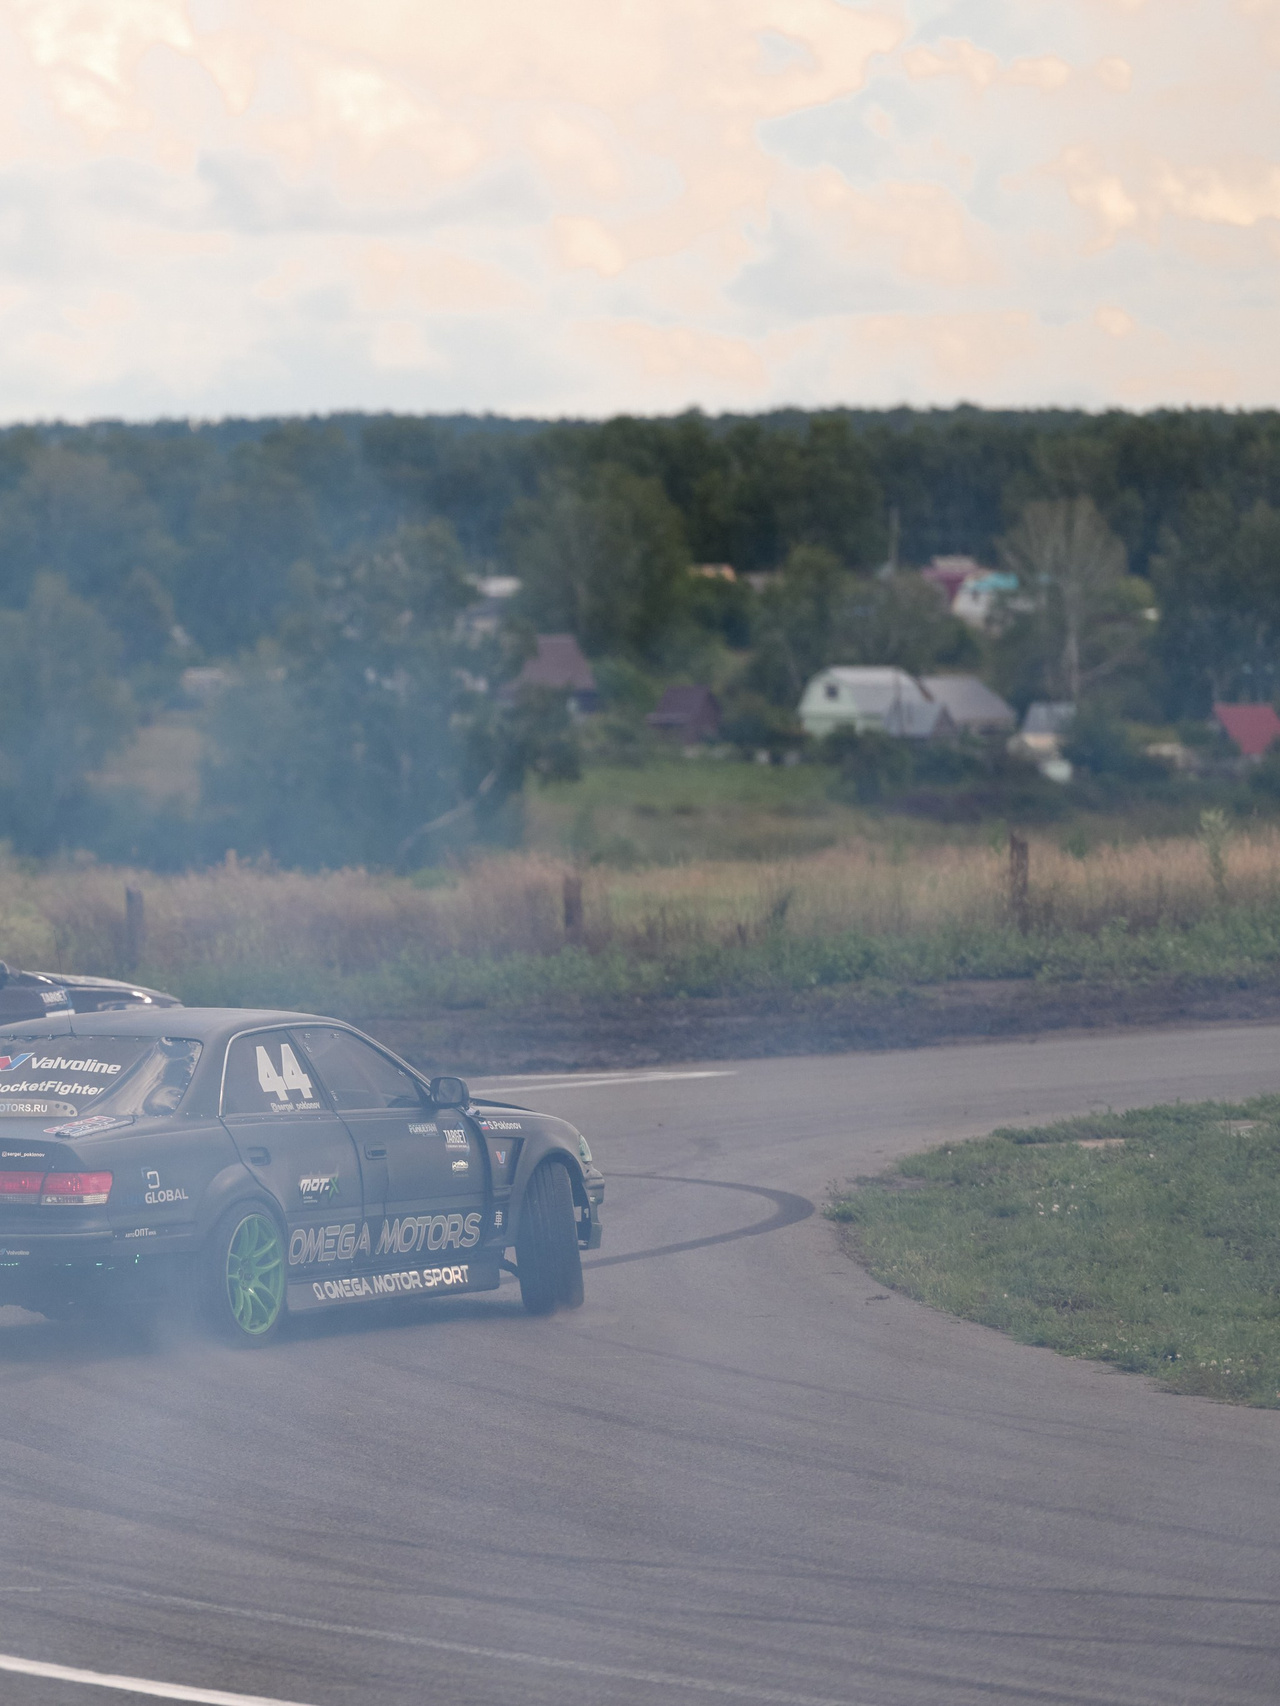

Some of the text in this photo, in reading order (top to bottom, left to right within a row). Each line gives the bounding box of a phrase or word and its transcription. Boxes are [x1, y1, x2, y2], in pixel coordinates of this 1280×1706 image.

[31, 1057, 121, 1075] Valvoline
[255, 1043, 313, 1101] 44
[144, 1188, 189, 1204] GLOBAL
[288, 1212, 482, 1265] OMEGA MOTORS
[324, 1278, 373, 1299] OMEGA
[373, 1271, 423, 1294] MOTOR
[423, 1265, 469, 1287] SPORT
